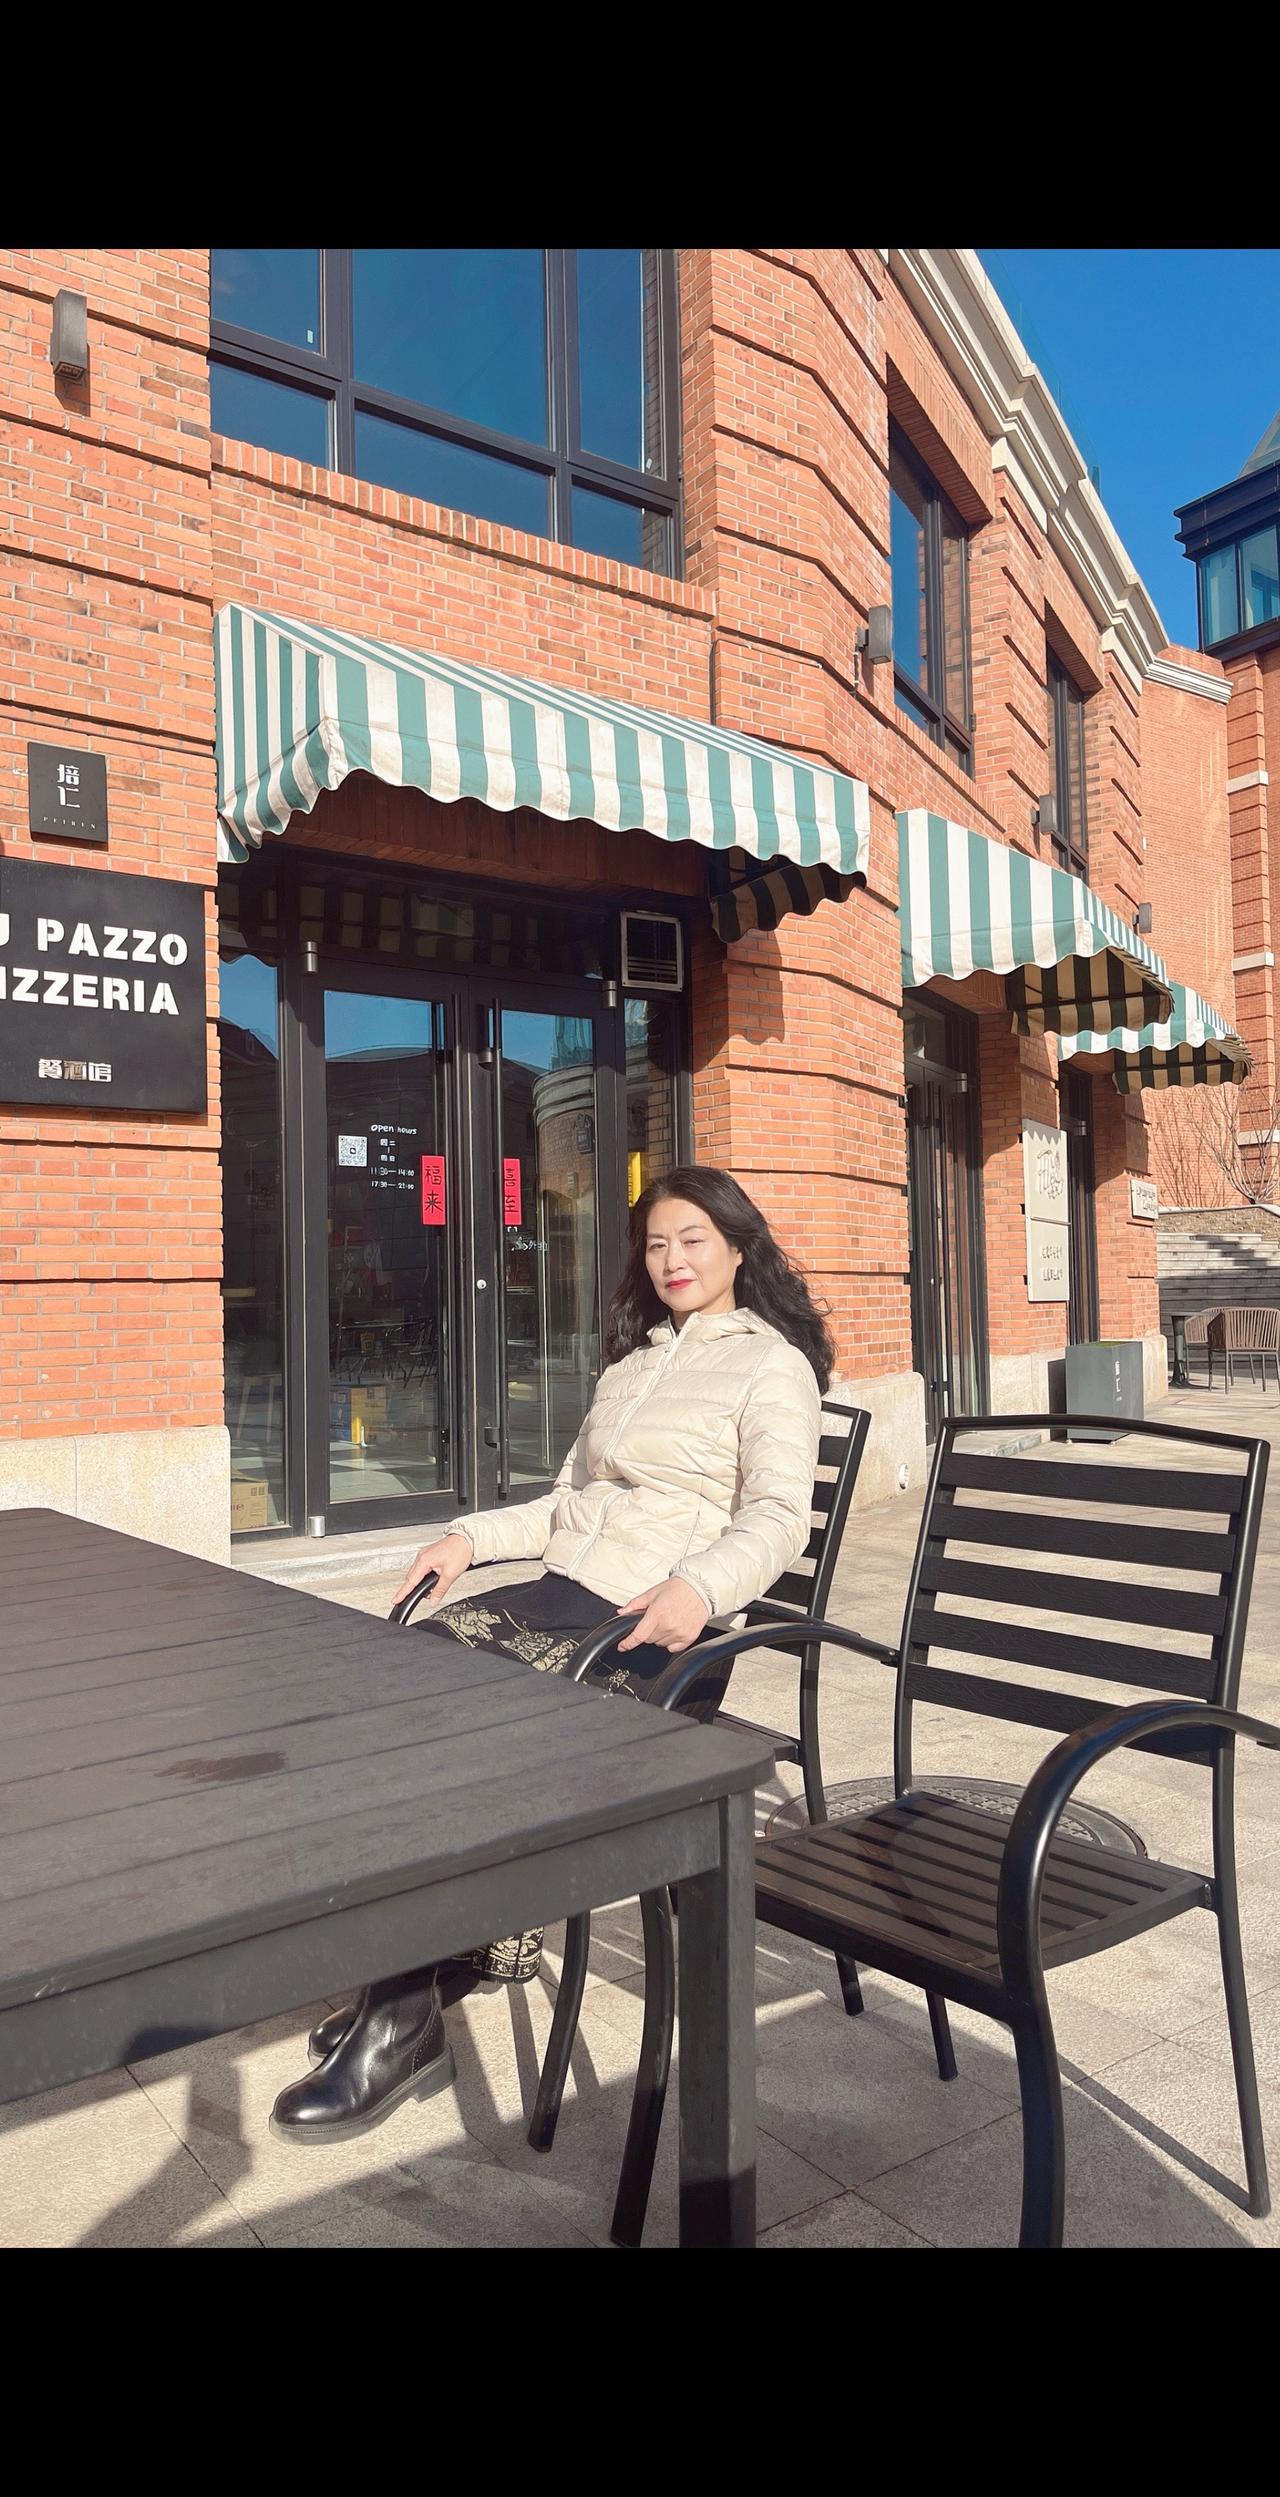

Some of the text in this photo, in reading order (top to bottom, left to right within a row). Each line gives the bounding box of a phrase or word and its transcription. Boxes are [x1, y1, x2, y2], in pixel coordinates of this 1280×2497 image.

[57, 764, 81, 808] 培仁
[37, 917, 188, 966] PAZZO
[38, 1058, 112, 1083] 餐酒馆
[424, 1165, 443, 1214] 福来
